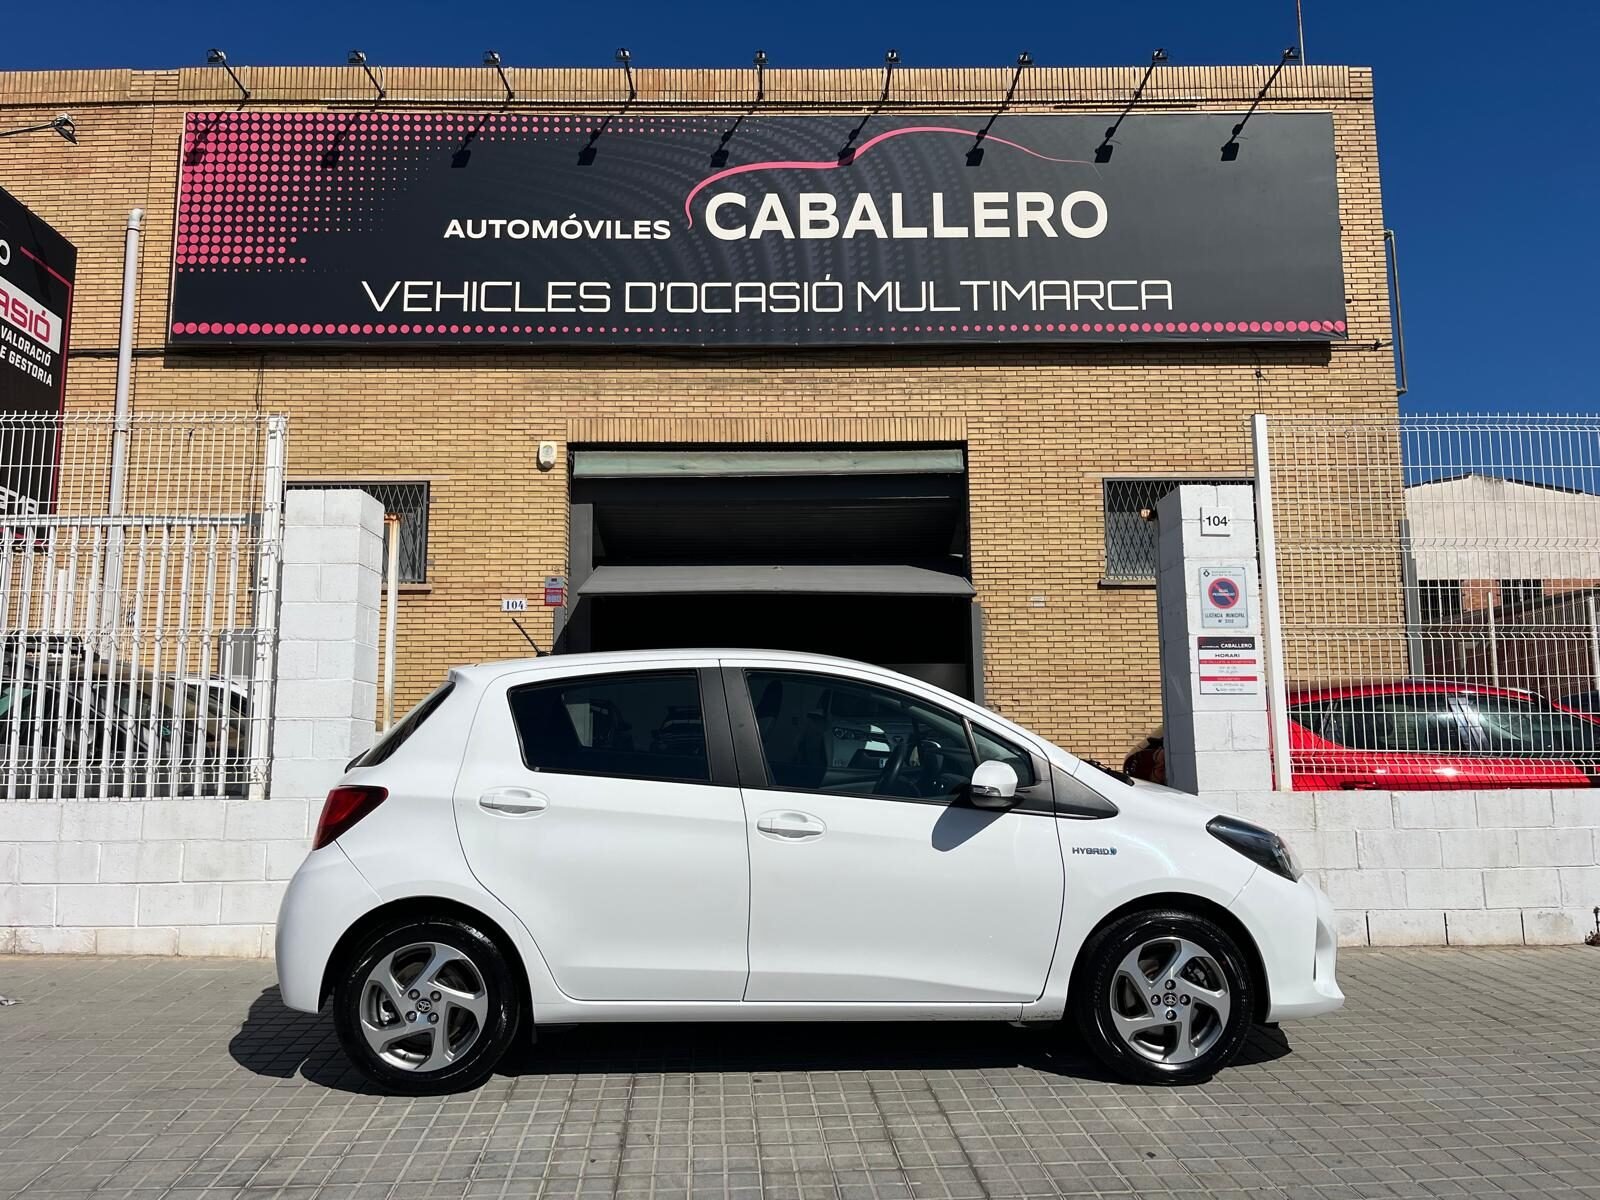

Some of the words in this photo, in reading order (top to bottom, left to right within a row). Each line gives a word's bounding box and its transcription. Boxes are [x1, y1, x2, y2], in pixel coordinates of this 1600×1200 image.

[443, 212, 671, 240] AUTOMÓVILES
[704, 189, 1108, 241] CABALLERO
[361, 280, 611, 314] VEHICLES
[623, 272, 843, 314] D'OCASIÓ
[856, 279, 1173, 312] MULTIMARCA
[1, 325, 51, 367] VALORACIÓ
[8, 350, 52, 387] GESTORIA
[1205, 515, 1229, 527] 104
[506, 600, 524, 610] 104
[1072, 846, 1110, 855] HYBRID
